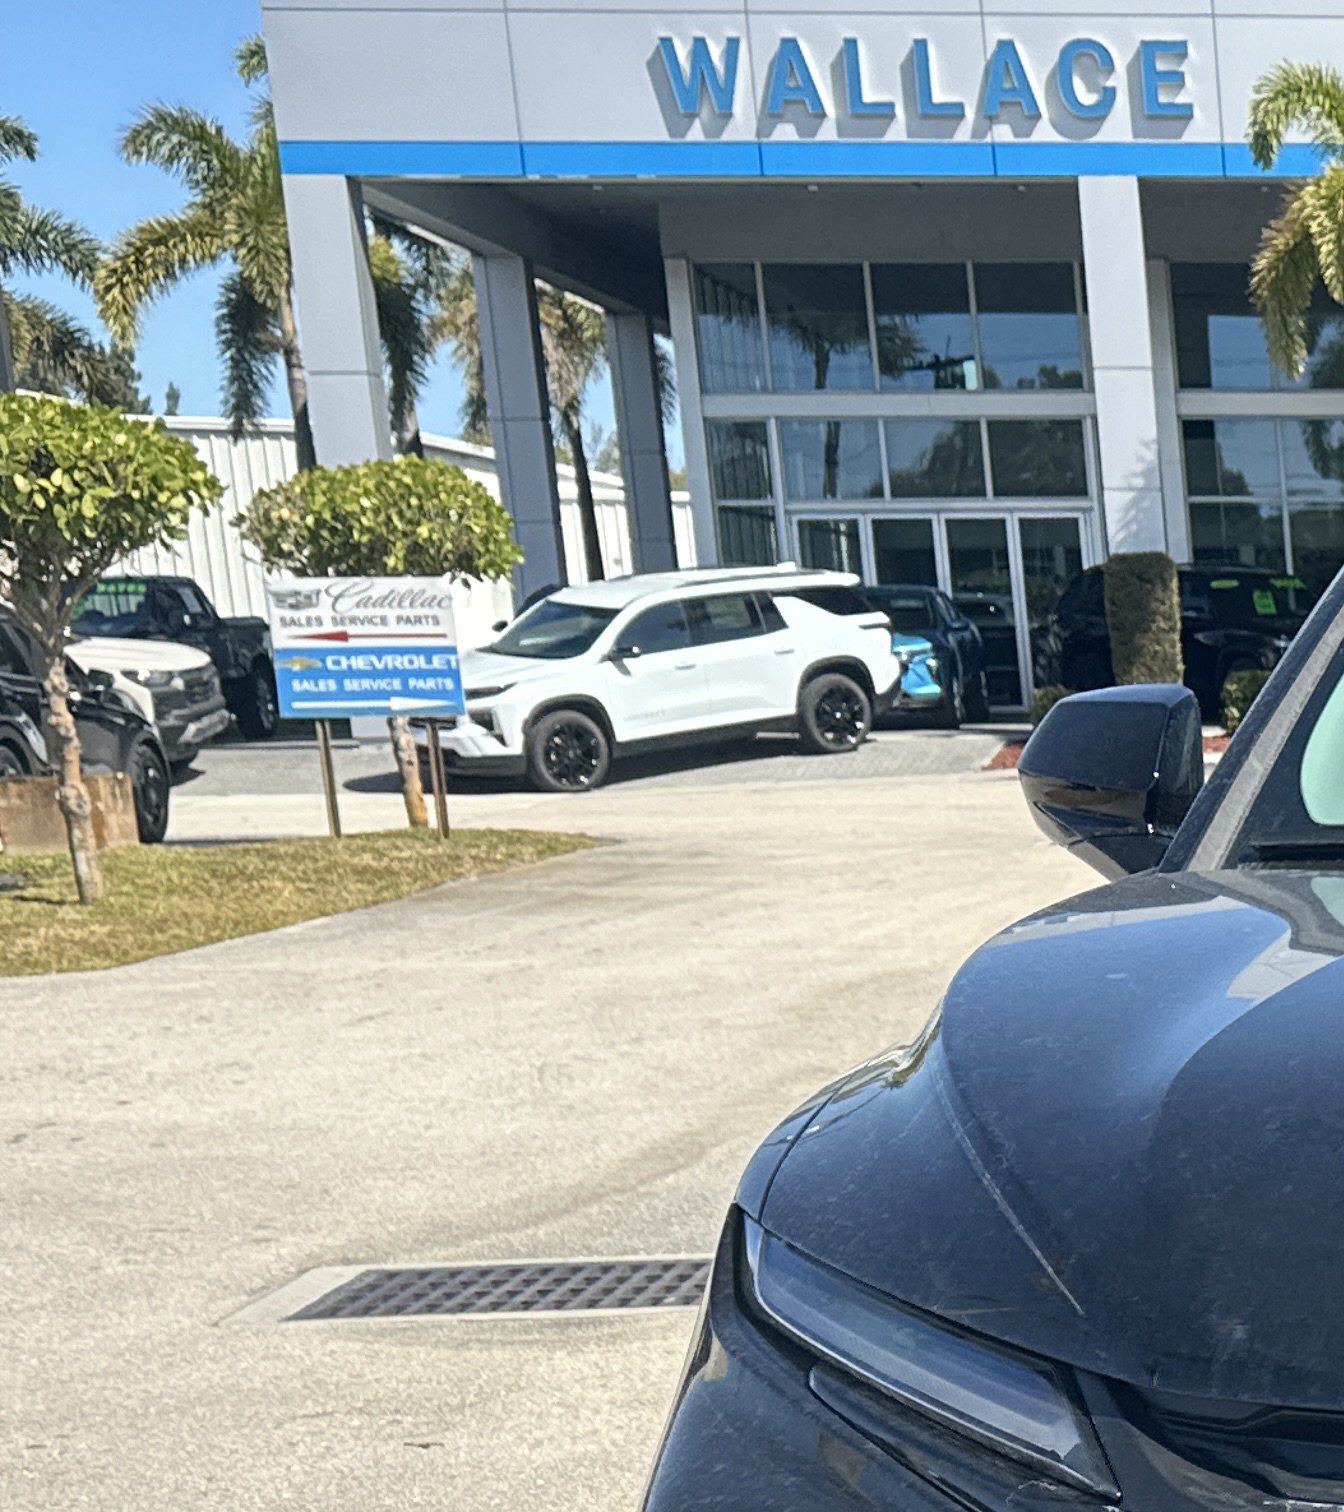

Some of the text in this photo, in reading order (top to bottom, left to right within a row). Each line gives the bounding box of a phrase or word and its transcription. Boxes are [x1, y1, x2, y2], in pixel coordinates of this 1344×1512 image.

[656, 36, 1194, 119] WALLACE
[324, 578, 452, 614] Cadillac
[279, 614, 440, 628] SALES SERVICE PARTS
[326, 654, 459, 671] CHEVROLET
[291, 677, 454, 692] SALES SERVICE PARTS
